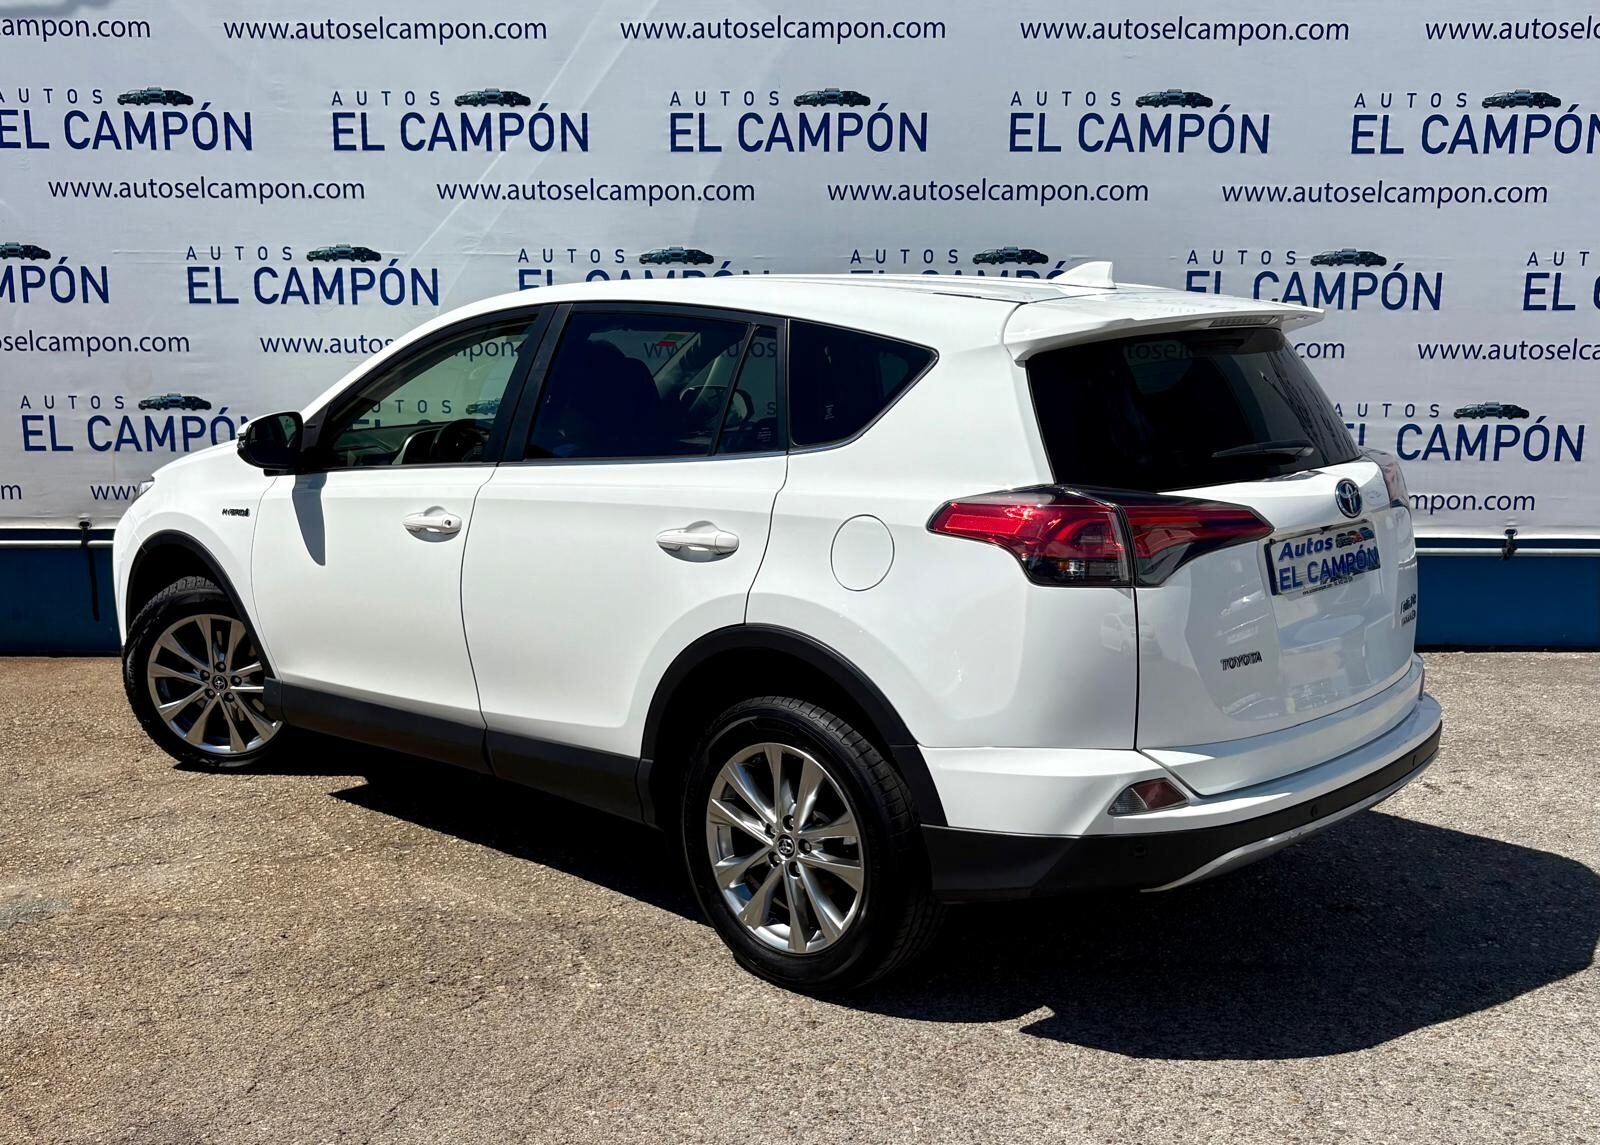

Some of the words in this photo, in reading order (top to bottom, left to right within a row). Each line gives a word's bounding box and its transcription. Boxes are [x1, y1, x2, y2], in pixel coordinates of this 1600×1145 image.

[0, 18, 151, 43] ampon.com
[223, 15, 547, 45] www.autoselcampon.com
[620, 14, 946, 45] www.autoselcampon.com
[1020, 15, 1349, 47] www.autoselcampon.com
[331, 90, 440, 106] AUTOS
[669, 90, 779, 107] AUTOS
[1010, 90, 1121, 107] AUTOS
[1353, 92, 1467, 109] AUTOS
[0, 109, 50, 150] EL
[64, 102, 253, 151] CAMPÓN
[332, 112, 386, 151] EL
[400, 102, 589, 152] CAMPÓN
[670, 112, 723, 153] EL
[738, 102, 928, 153] CAMPÓN
[1009, 112, 1062, 153] EL
[1078, 103, 1270, 154] CAMPÓN
[1351, 114, 1405, 155] EL
[47, 175, 365, 205] www.autoselcampon.com
[436, 177, 755, 207] www.autoselcampon.com
[827, 177, 1149, 207] www.autoselcampon.com
[1222, 179, 1548, 209] www.autoselcampon.com
[186, 245, 293, 261] AUTOS
[517, 248, 625, 264] AUTOS
[849, 248, 959, 265] AUTOS
[1186, 249, 1296, 266] AUTOS
[187, 266, 239, 305] EL
[253, 258, 439, 306] CAMPÓN
[1253, 262, 1443, 311] CAMPÓN
[1522, 272, 1576, 311] EL
[0, 329, 190, 358] selcampon.com
[20, 394, 125, 410] AUTOS
[1335, 402, 1440, 418] AUTOS
[21, 414, 74, 452] EL
[87, 407, 248, 452] CAMPÓ
[1396, 415, 1585, 462] CAMPÓN
[1278, 536, 1333, 562] Autos
[1278, 566, 1303, 591] EL
[1307, 544, 1380, 584] CAMPÓN
[1220, 651, 1263, 671] TOYOTA
